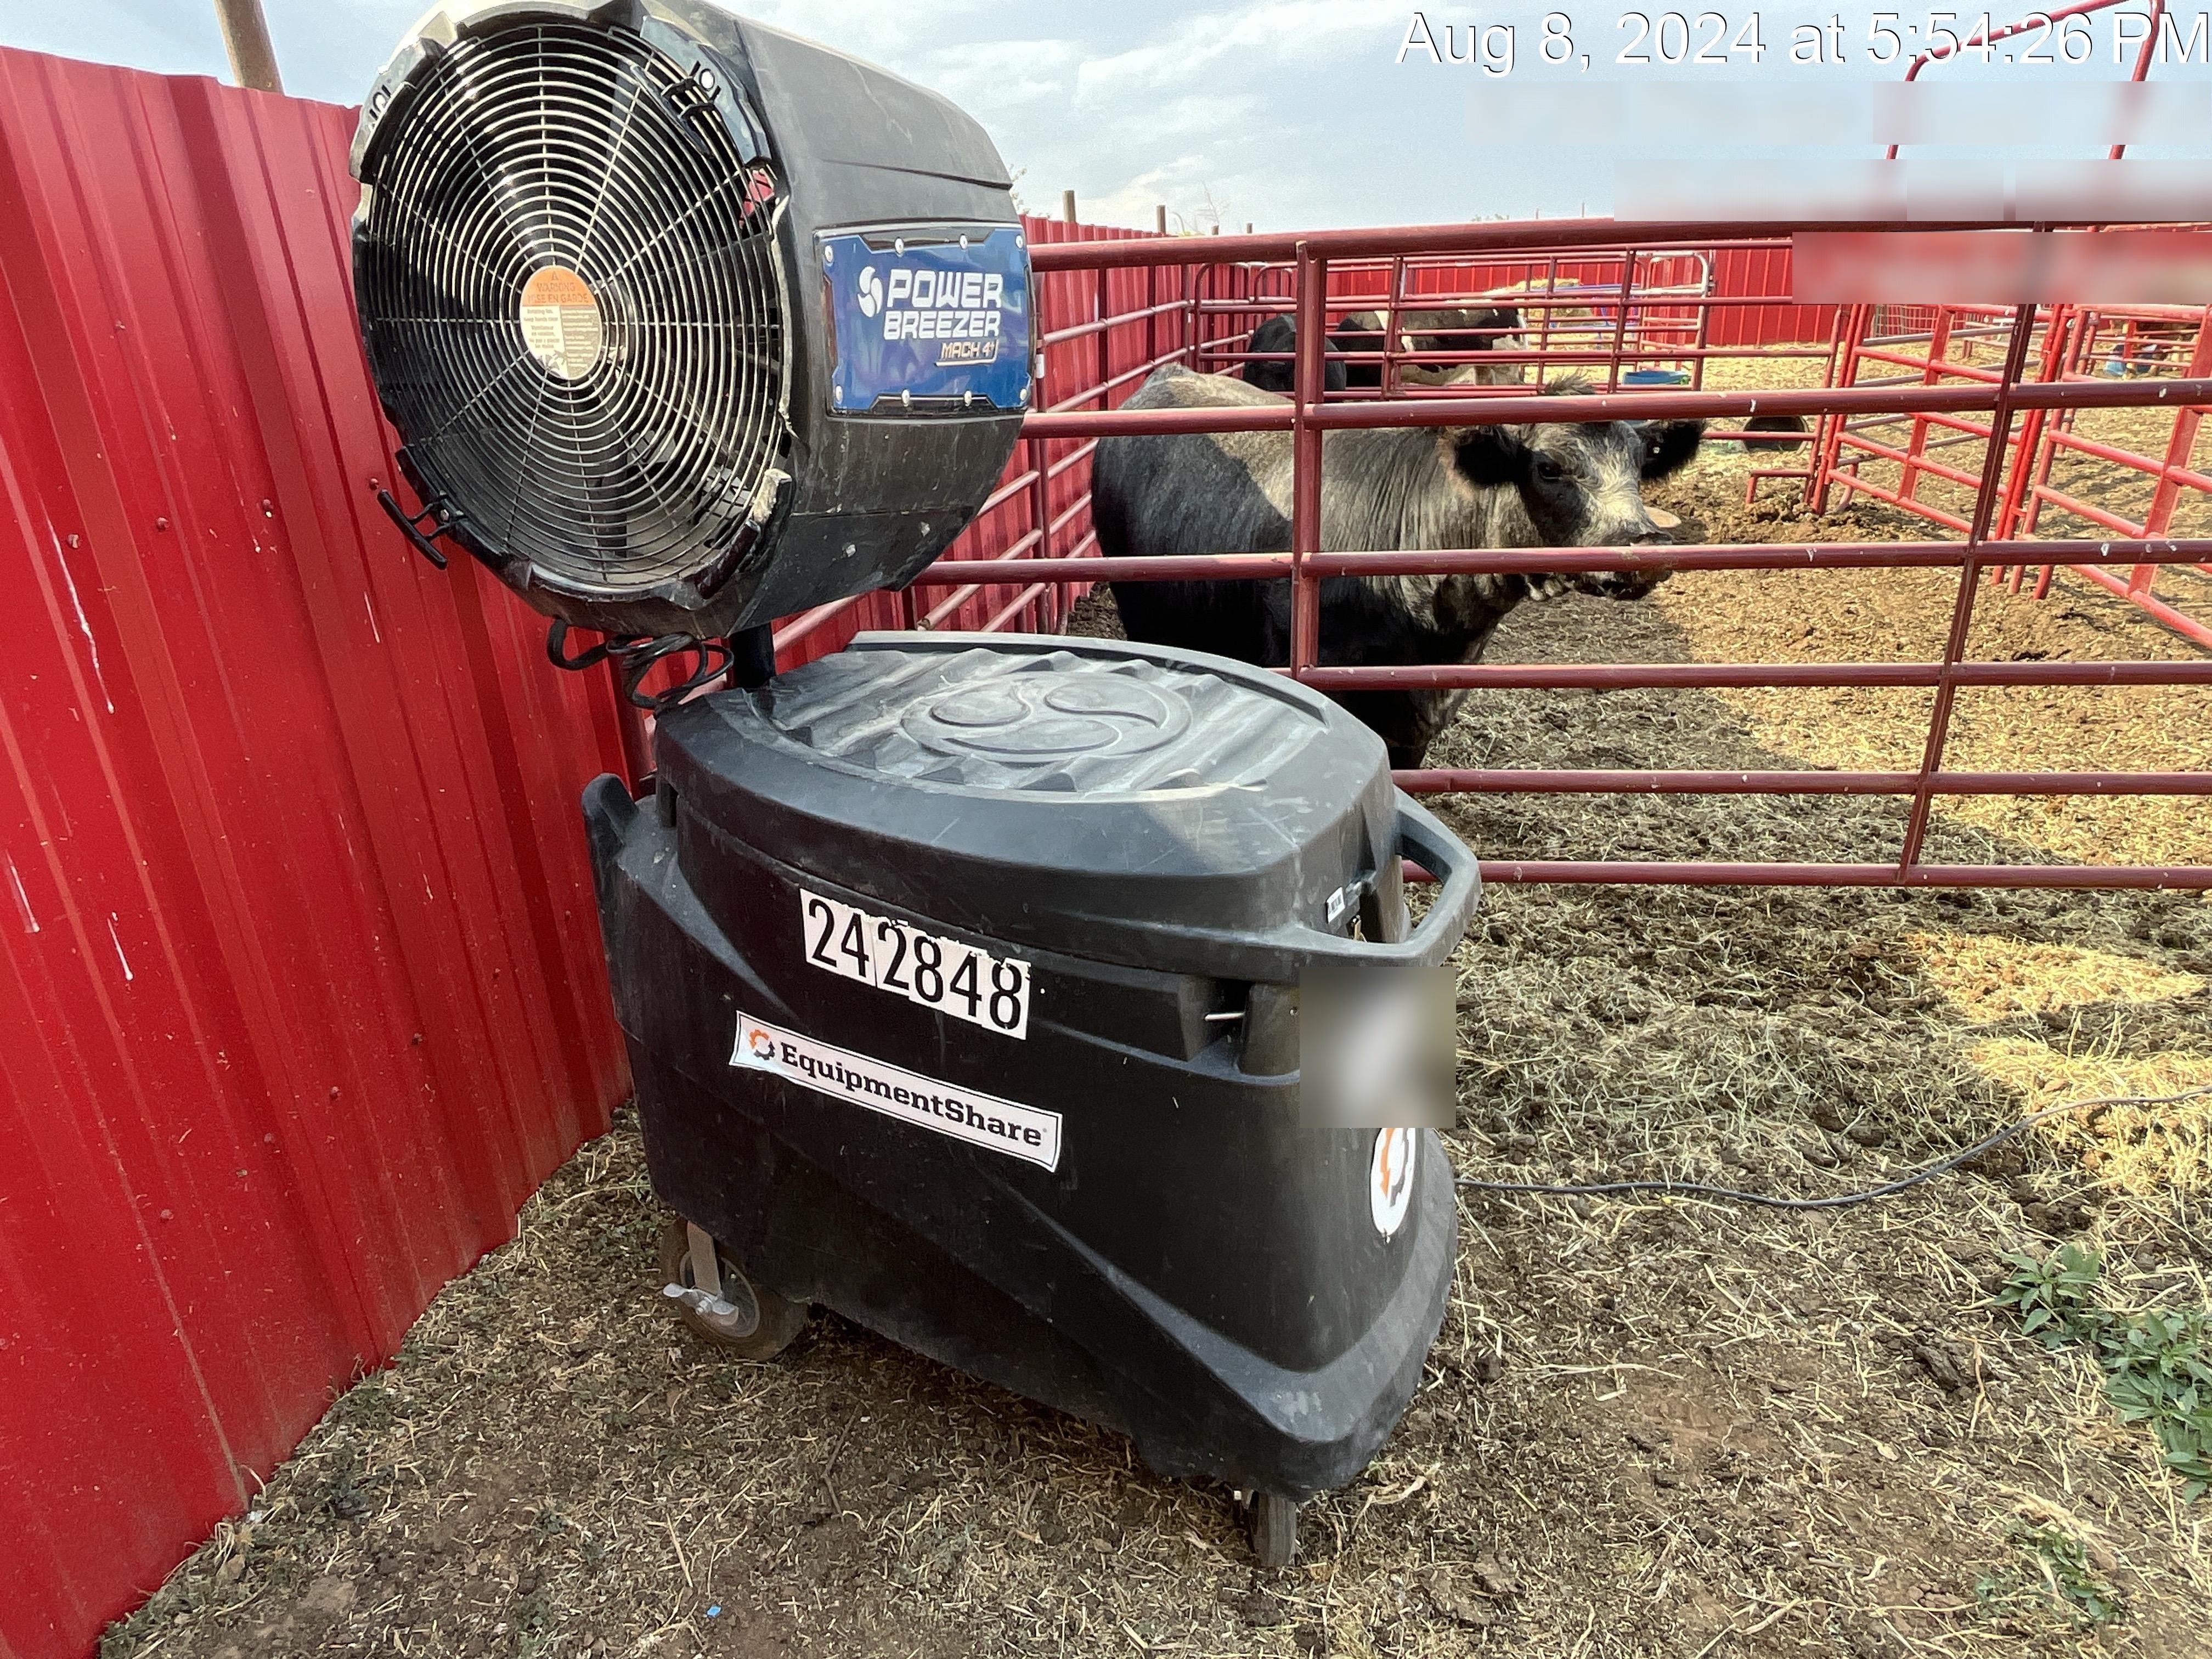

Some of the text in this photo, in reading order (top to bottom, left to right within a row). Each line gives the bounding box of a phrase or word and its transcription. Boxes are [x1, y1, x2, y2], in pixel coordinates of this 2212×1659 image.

[887, 269, 1003, 308] POWER
[883, 311, 1001, 340] BREEZER
[940, 341, 981, 359] MACH
[808, 898, 1022, 1029] 242848
